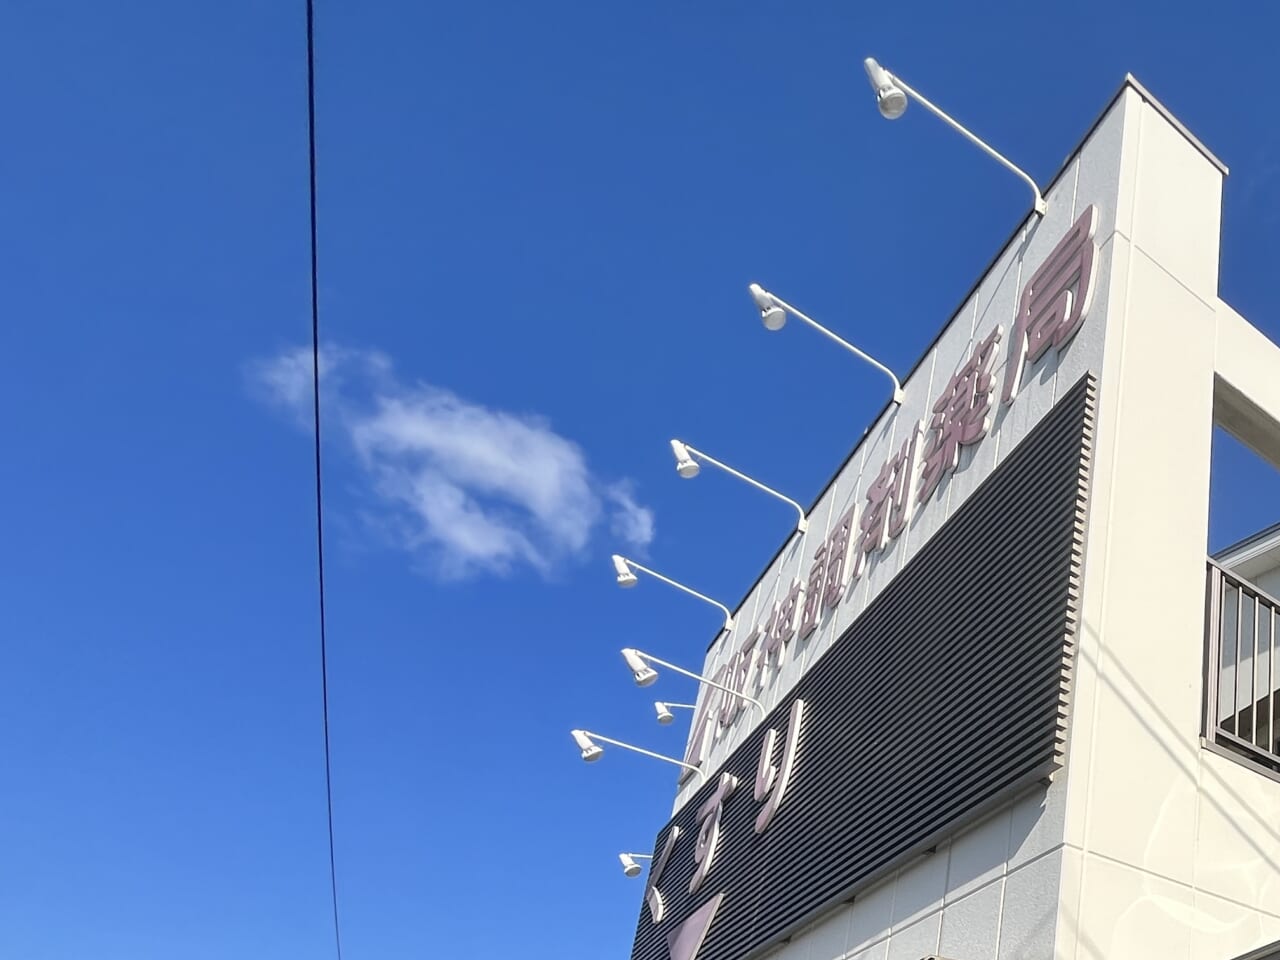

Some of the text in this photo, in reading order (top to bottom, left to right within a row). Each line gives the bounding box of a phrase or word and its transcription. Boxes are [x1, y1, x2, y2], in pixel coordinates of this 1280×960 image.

[719, 204, 1100, 728] 阪神調剤薬局
[647, 698, 804, 923] くすり
